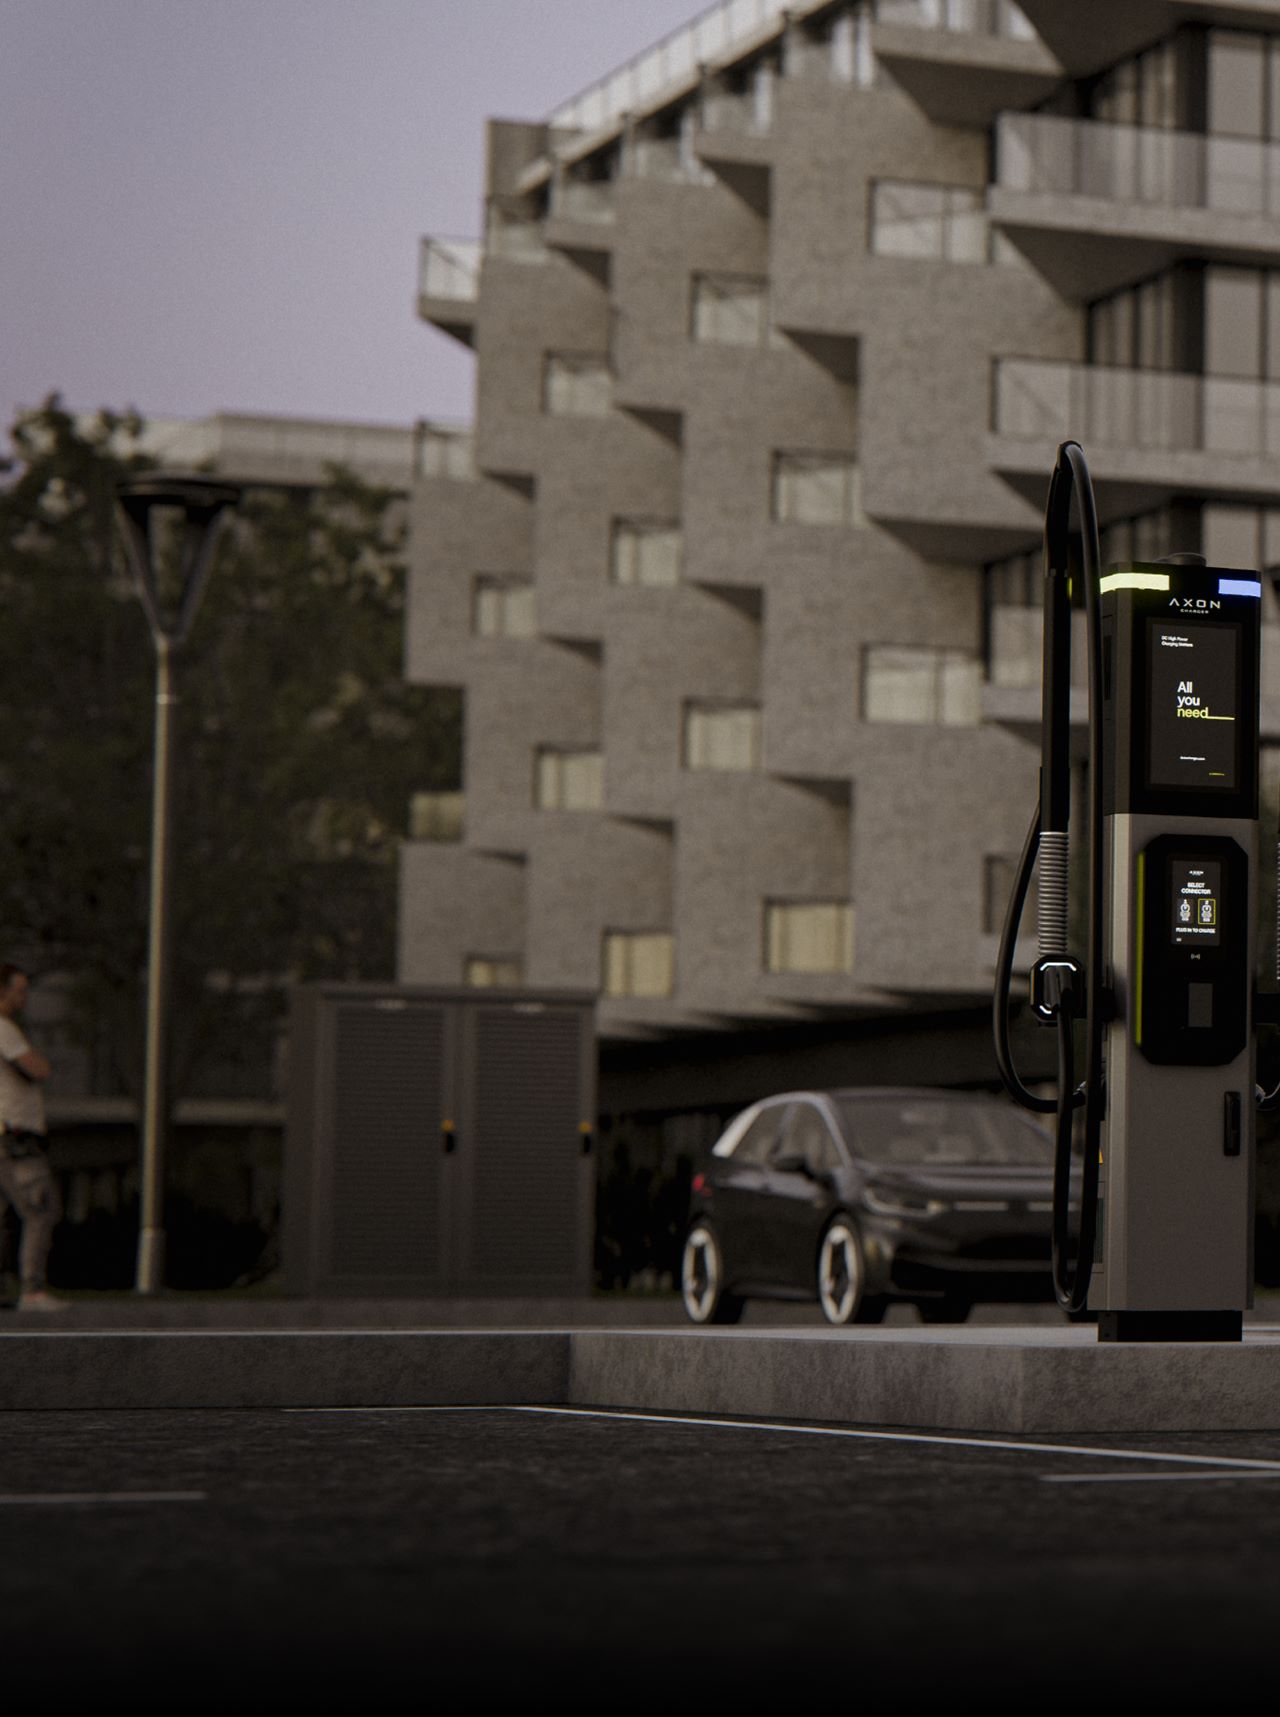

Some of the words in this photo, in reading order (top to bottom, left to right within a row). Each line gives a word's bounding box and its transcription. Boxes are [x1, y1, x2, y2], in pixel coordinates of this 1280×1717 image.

[1169, 598, 1221, 609] AXON
[1177, 681, 1193, 693] All
[1177, 696, 1200, 708] you
